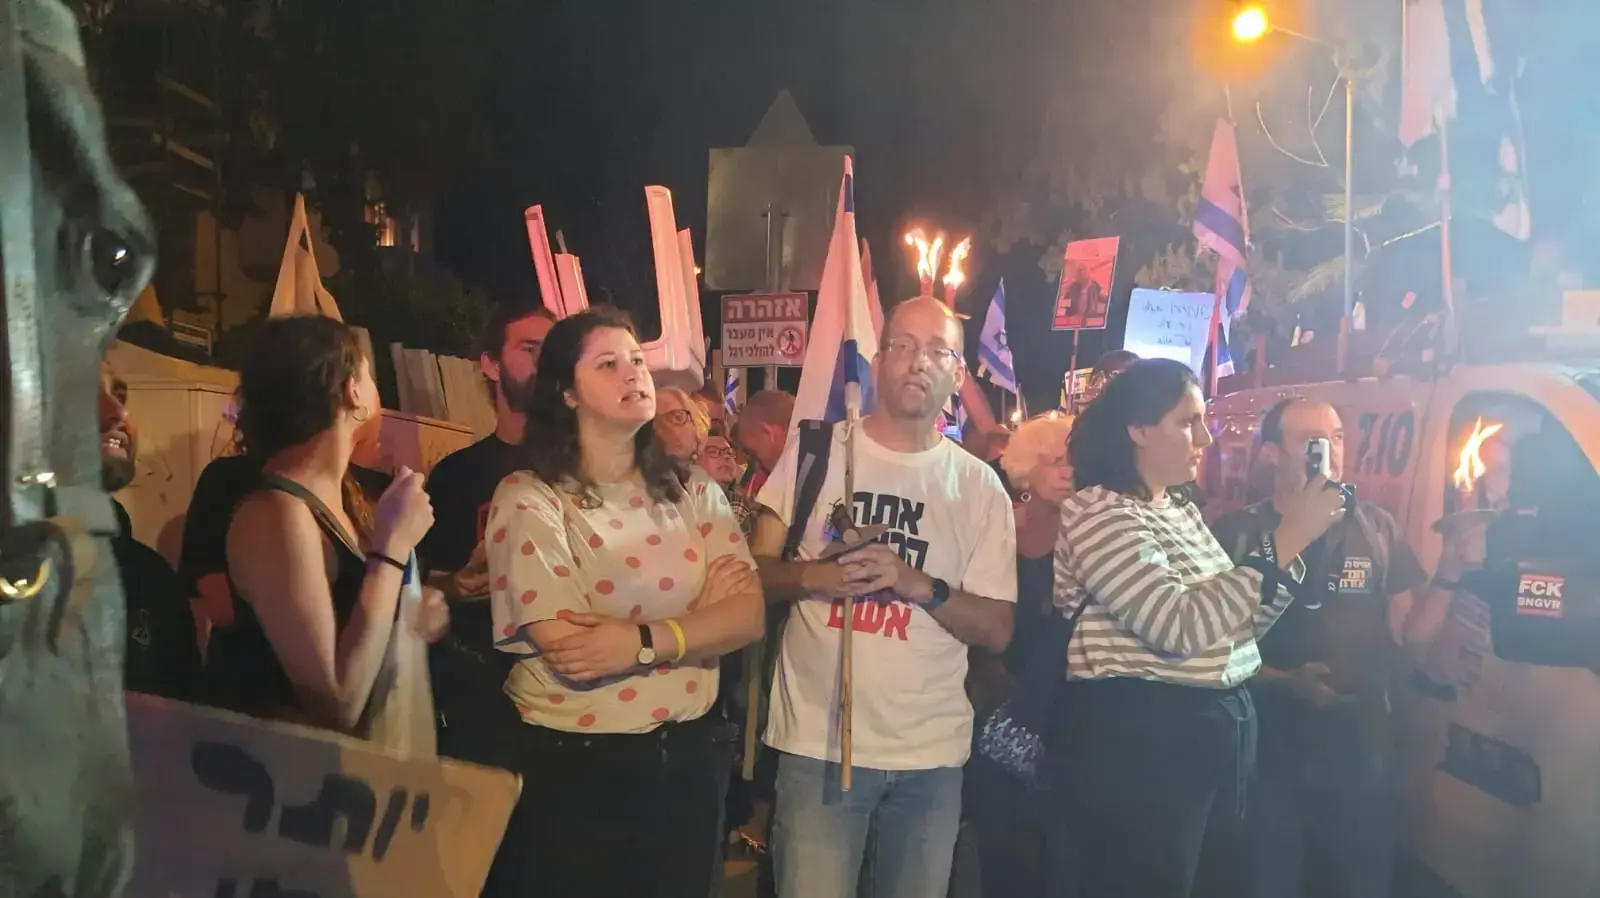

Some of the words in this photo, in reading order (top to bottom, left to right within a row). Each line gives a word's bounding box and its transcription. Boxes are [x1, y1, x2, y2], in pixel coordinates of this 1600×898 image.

[727, 298, 801, 319] אזהרה
[726, 328, 756, 340] מעבר
[759, 327, 775, 342] אין
[728, 345, 744, 358] רגל
[745, 344, 775, 357] להולכי
[1354, 409, 1414, 476] 7.10
[852, 491, 925, 535] אתה
[1519, 580, 1564, 598] FCK
[1517, 597, 1561, 609] BNGVR
[827, 599, 912, 641] אשם
[191, 741, 430, 863] יותר
